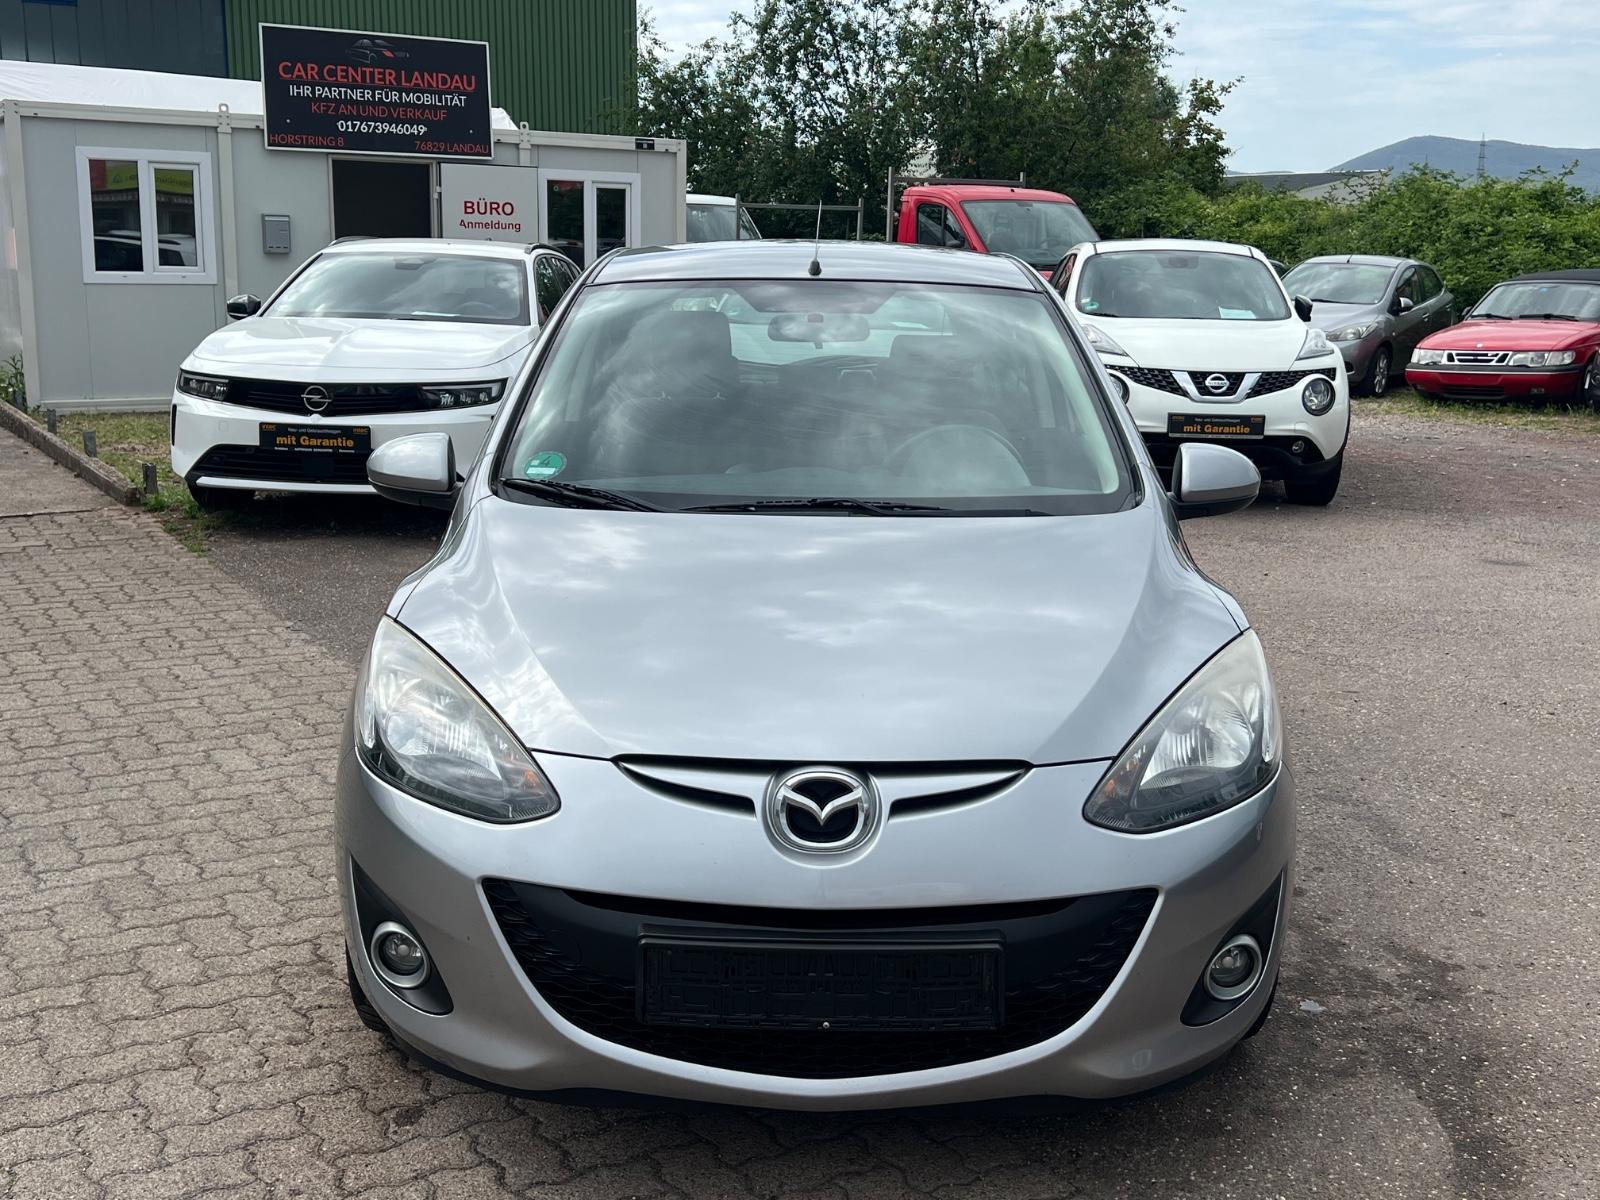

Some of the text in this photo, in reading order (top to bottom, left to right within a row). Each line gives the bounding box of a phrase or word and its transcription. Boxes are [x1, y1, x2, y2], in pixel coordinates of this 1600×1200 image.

[278, 61, 476, 91] CAR CENTER LANDAU
[289, 85, 467, 107] IHR PARTNER FÜR MOBILITÄT
[311, 102, 448, 121] KFZ AN UND VERKAUF
[338, 120, 425, 136] 017673946049
[270, 133, 345, 147] HORSTRING 8
[414, 140, 489, 154] 76829 LANDAU
[463, 198, 515, 216] BÜRO
[459, 219, 521, 233] Anmeldung
[1183, 424, 1250, 434] mit Garantie
[276, 435, 354, 447] mit Garantie
[539, 455, 552, 467] 4
